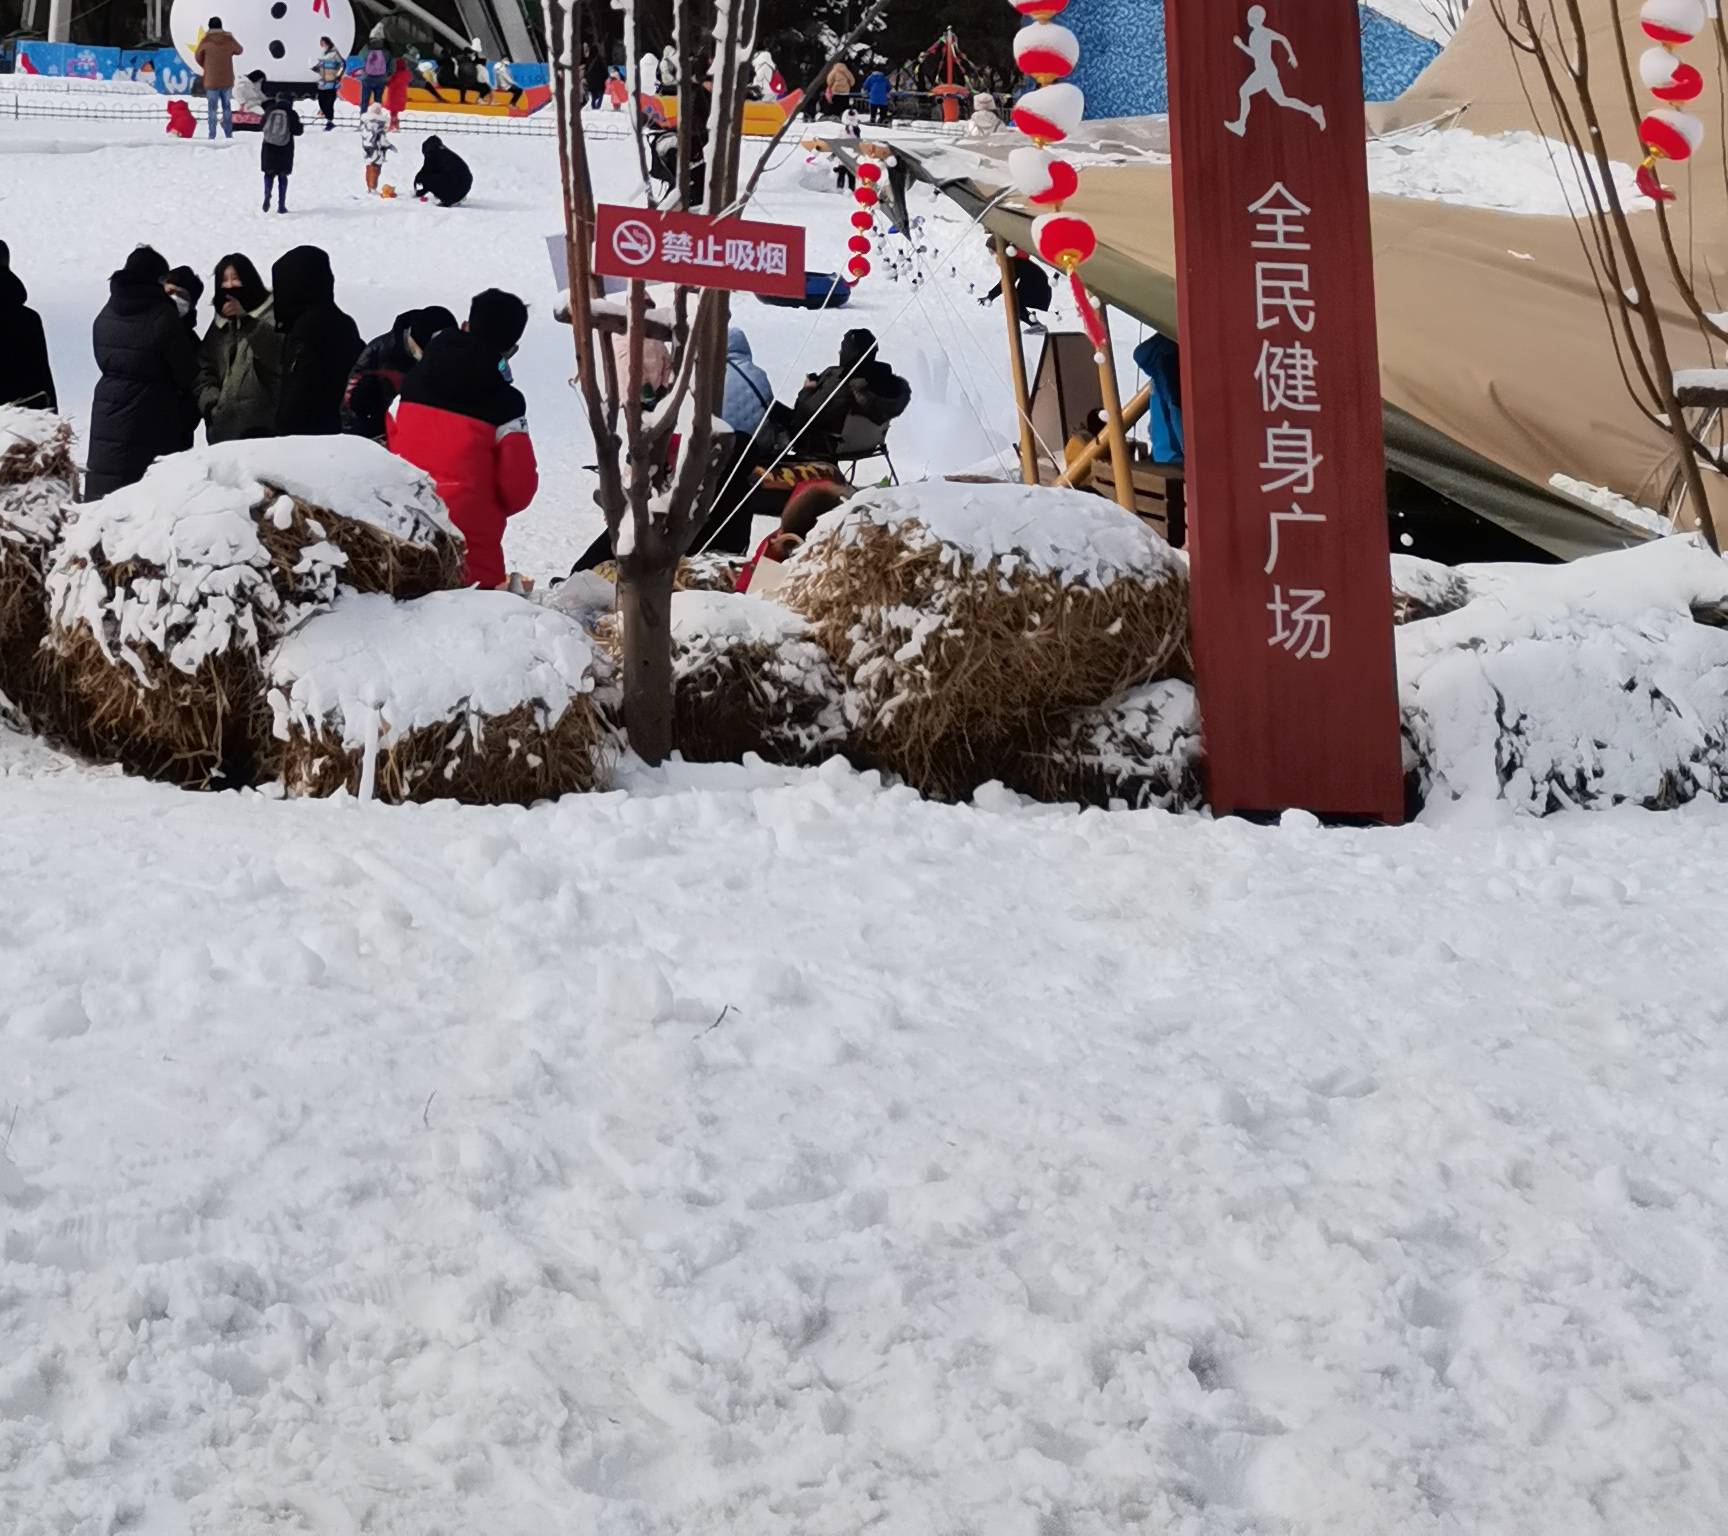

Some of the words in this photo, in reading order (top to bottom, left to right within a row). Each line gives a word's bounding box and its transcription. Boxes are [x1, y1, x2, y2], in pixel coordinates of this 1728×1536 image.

[660, 229, 787, 276] 禁止吸烟
[1246, 181, 1331, 659] 全民健身广场
